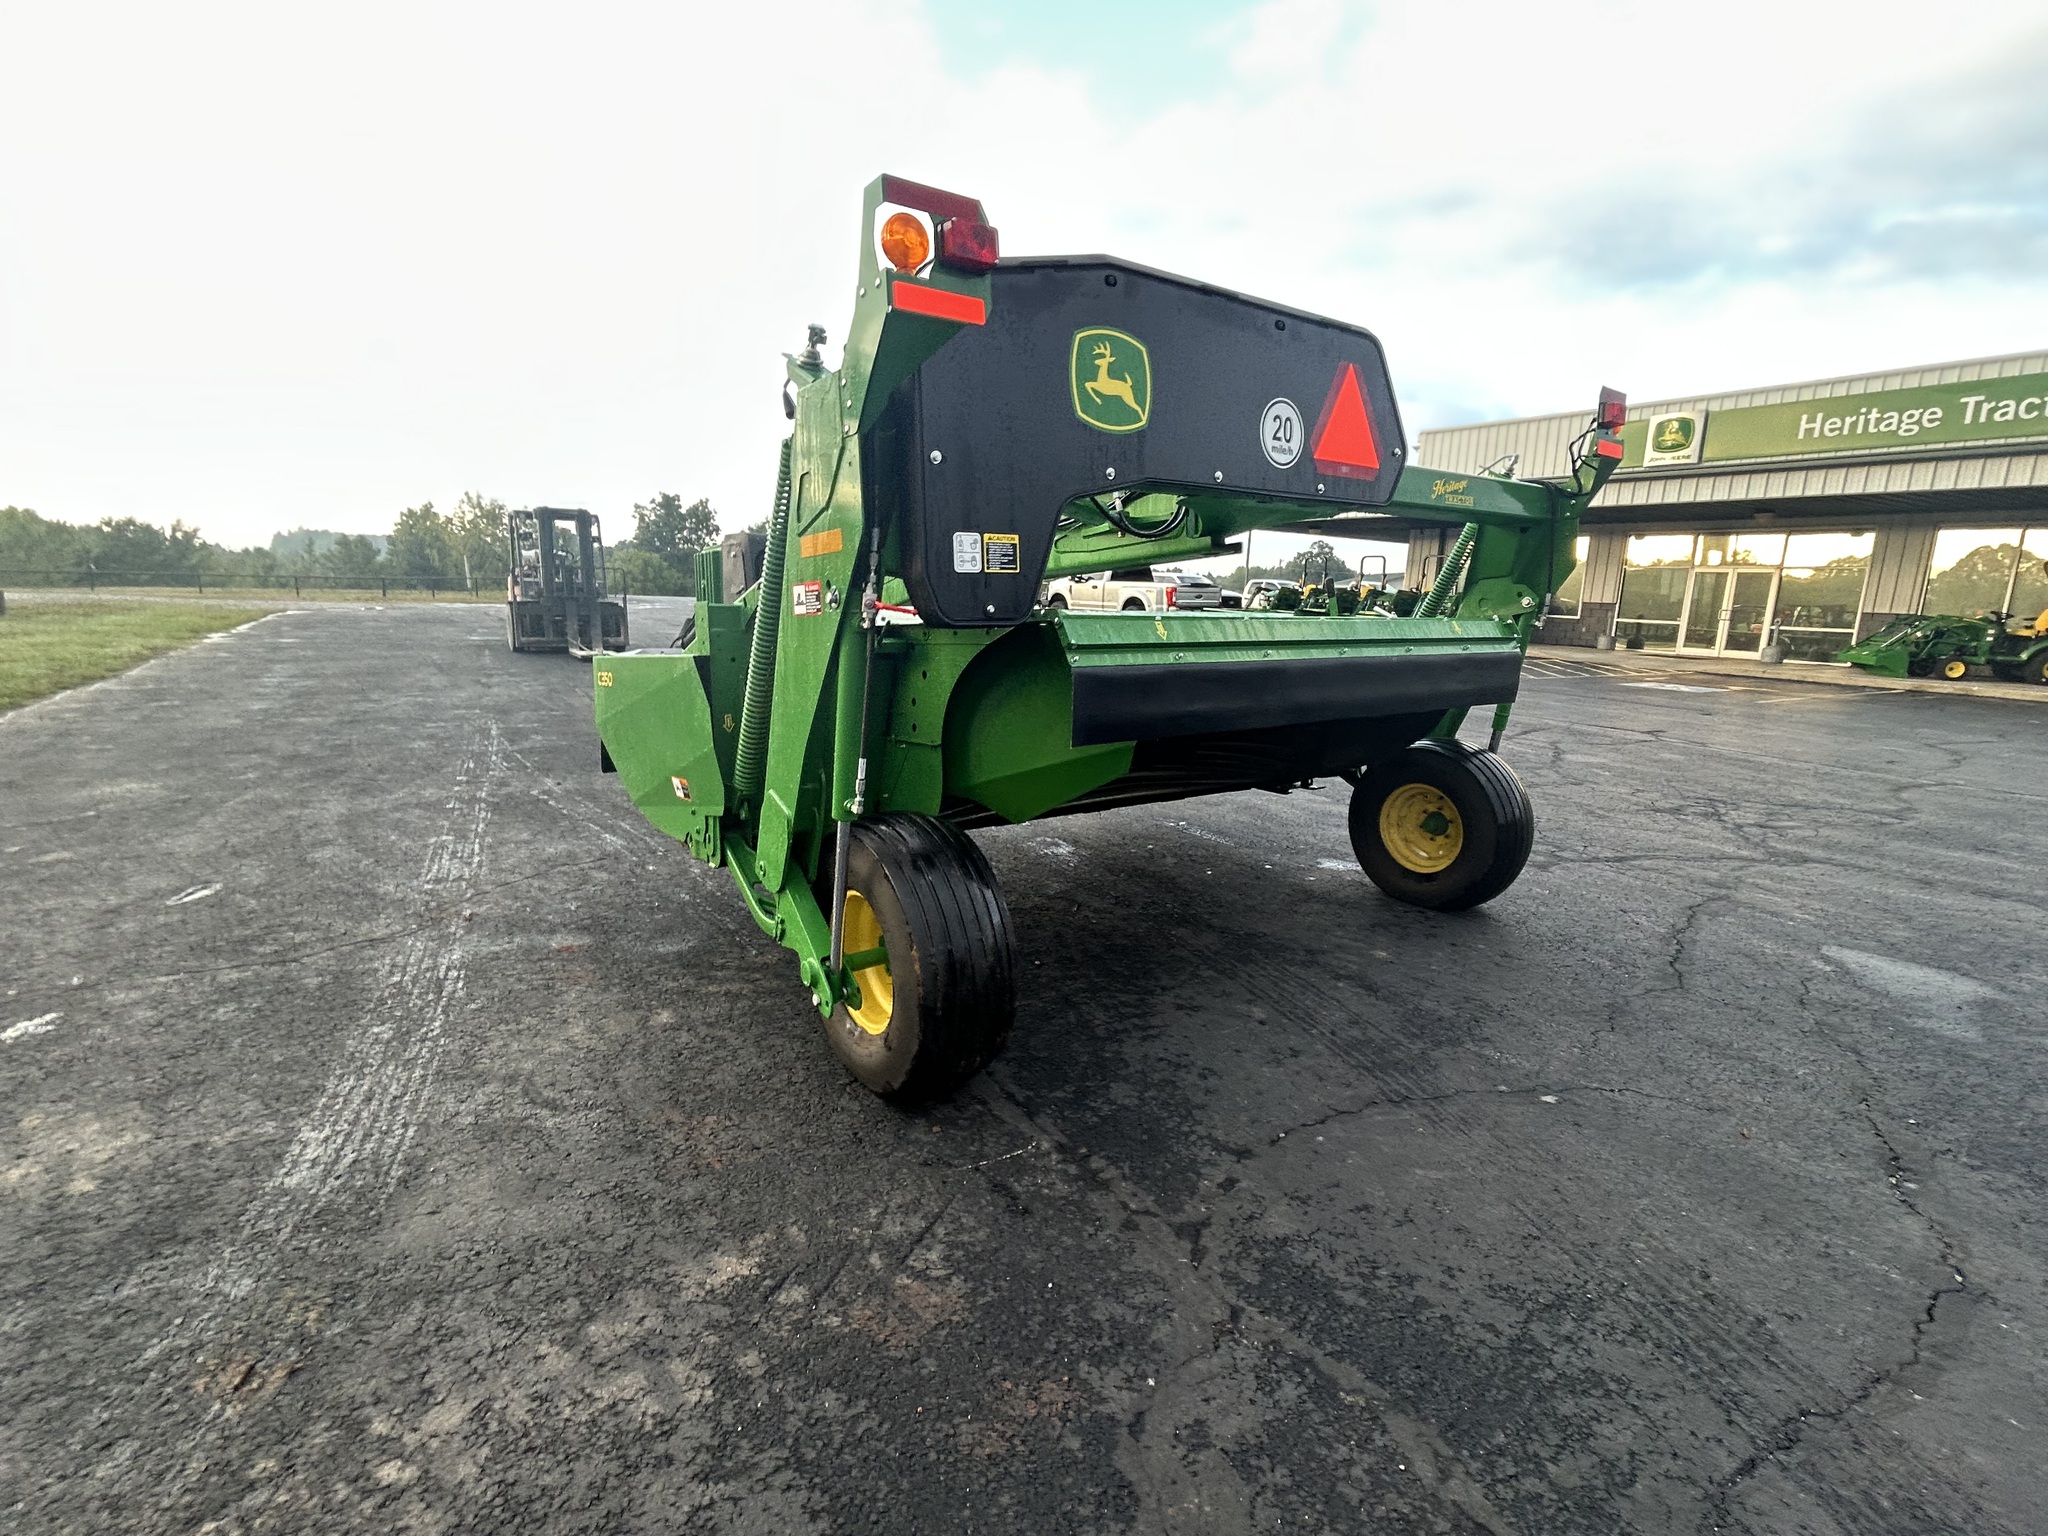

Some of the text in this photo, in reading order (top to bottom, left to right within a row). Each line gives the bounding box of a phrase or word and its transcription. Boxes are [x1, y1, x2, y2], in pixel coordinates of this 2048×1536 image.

[1272, 415, 1292, 443] 20
[1797, 407, 1943, 441] Heritage
[1271, 445, 1294, 456] mile/h
